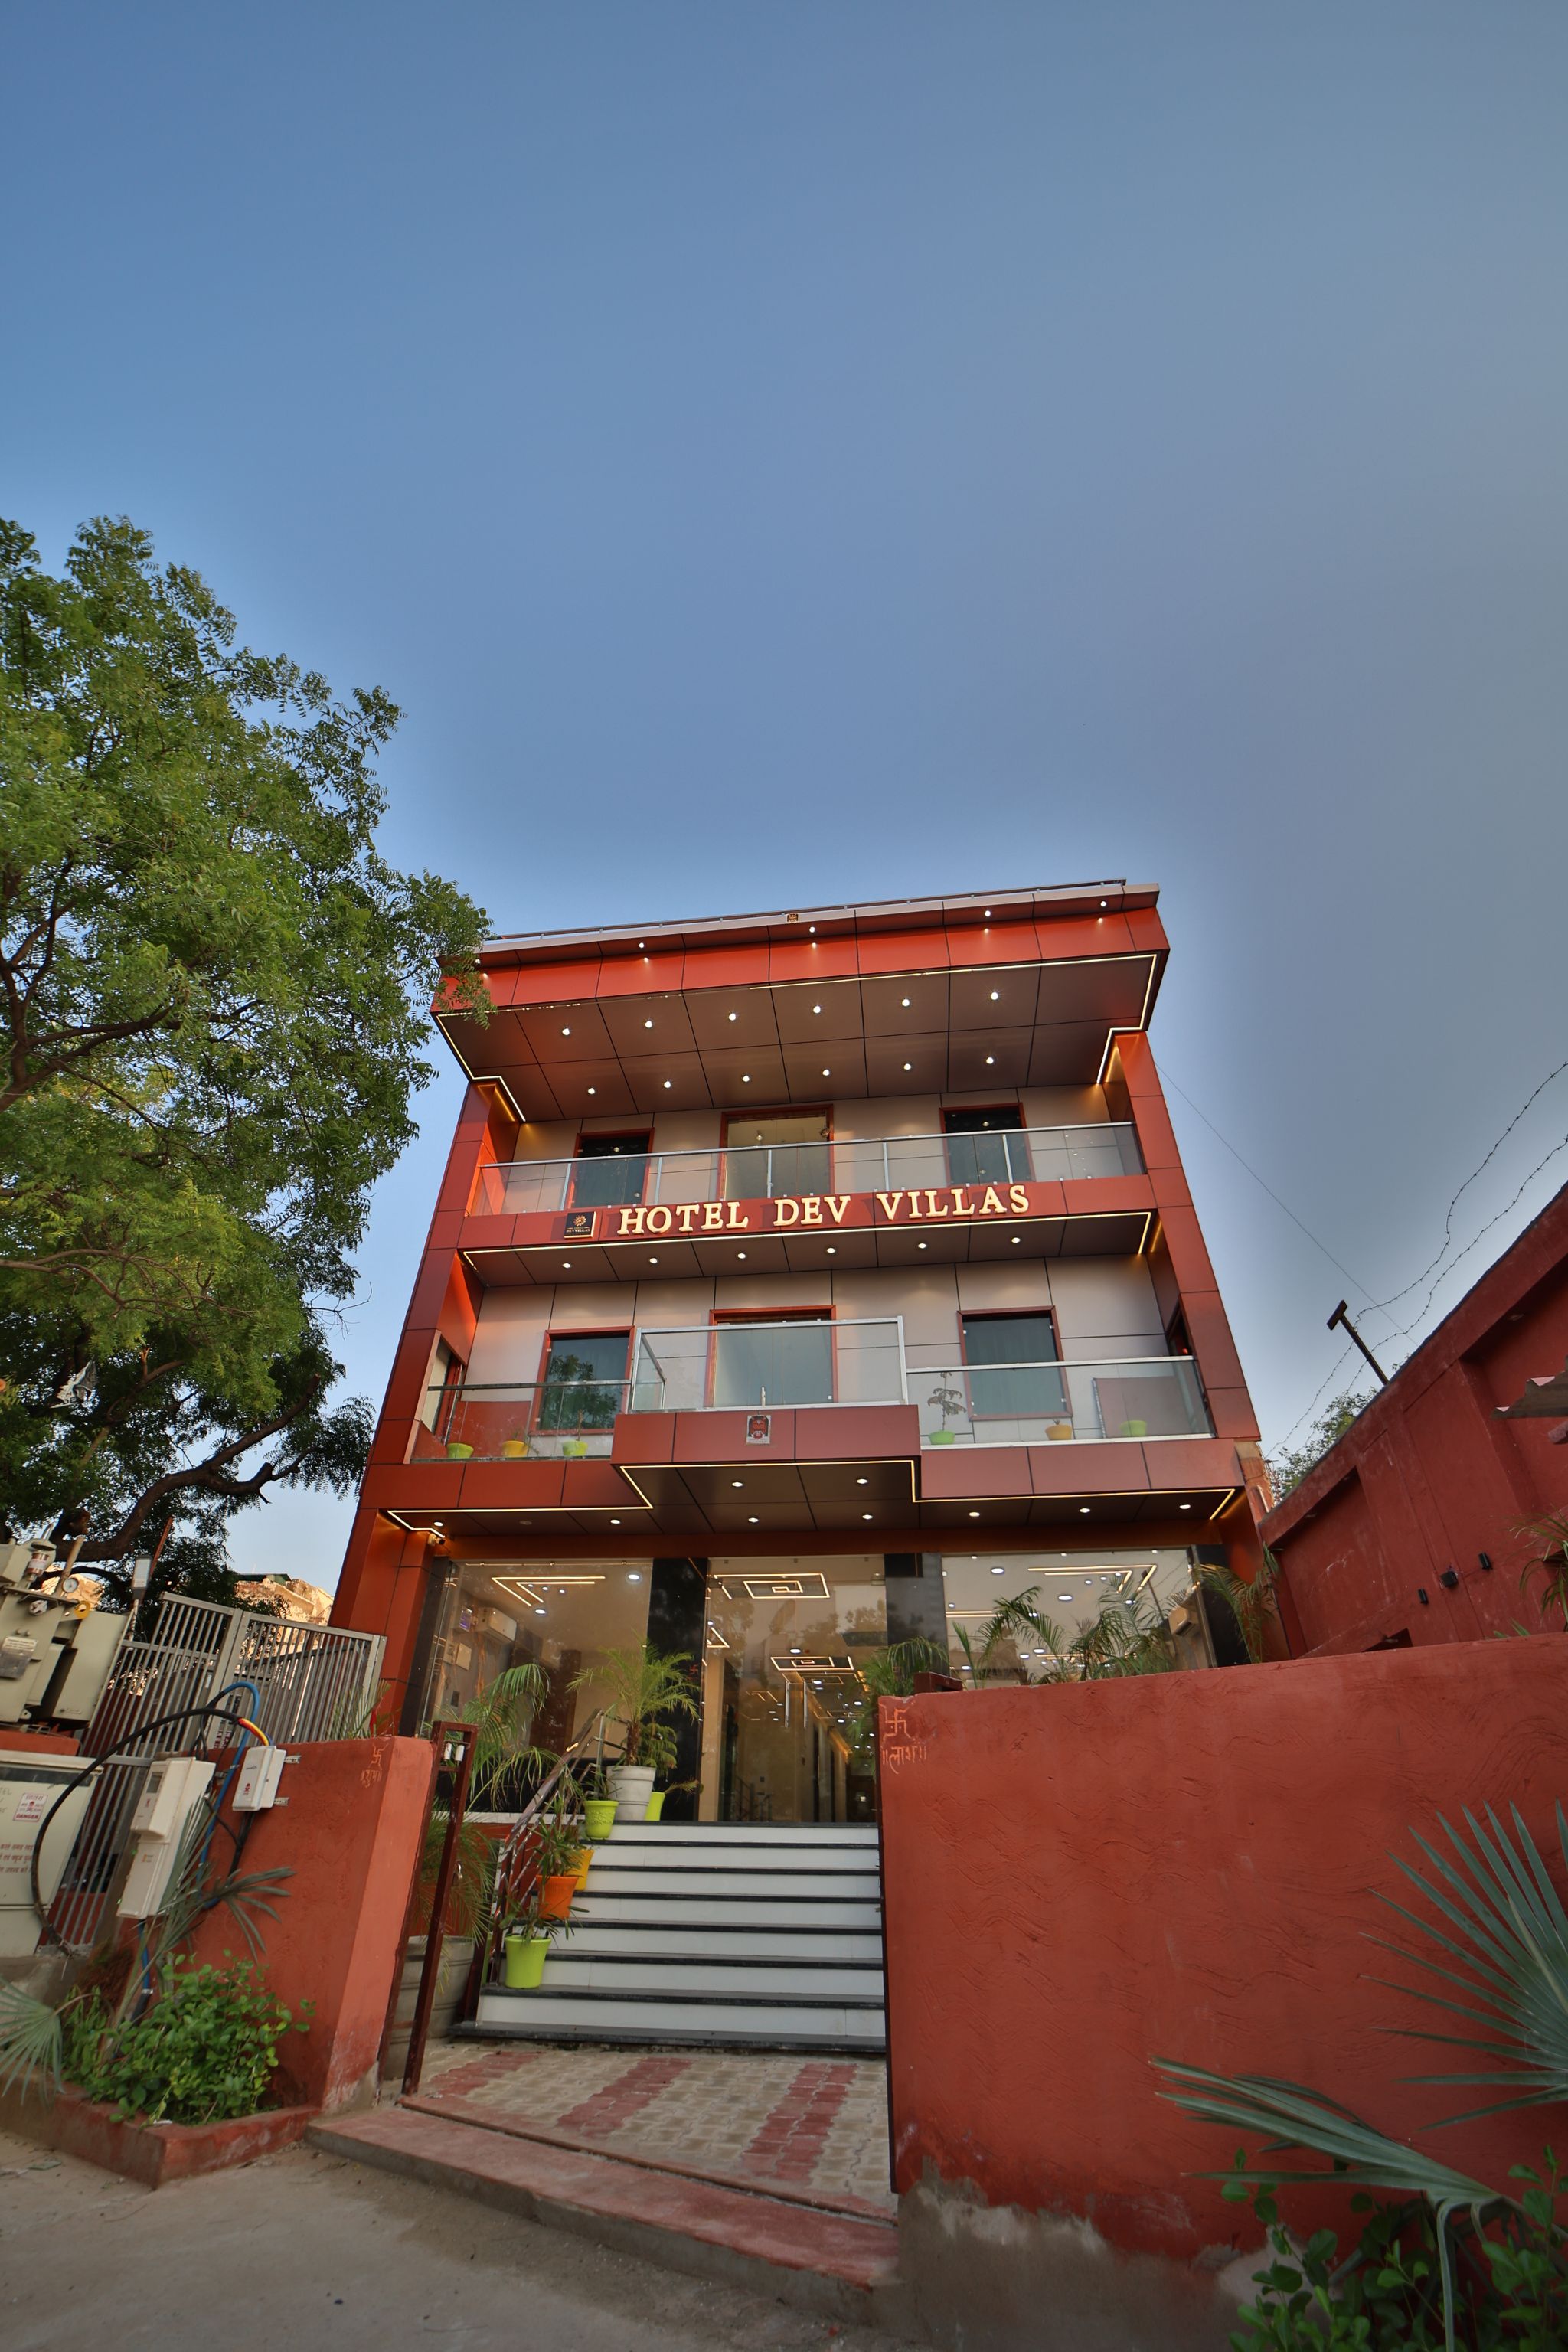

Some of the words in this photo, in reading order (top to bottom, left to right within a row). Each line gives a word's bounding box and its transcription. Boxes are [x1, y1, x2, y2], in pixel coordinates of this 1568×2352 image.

[617, 1202, 749, 1235] HOTEL
[773, 1195, 851, 1227] DEV
[876, 1184, 1030, 1220] VILLAS
